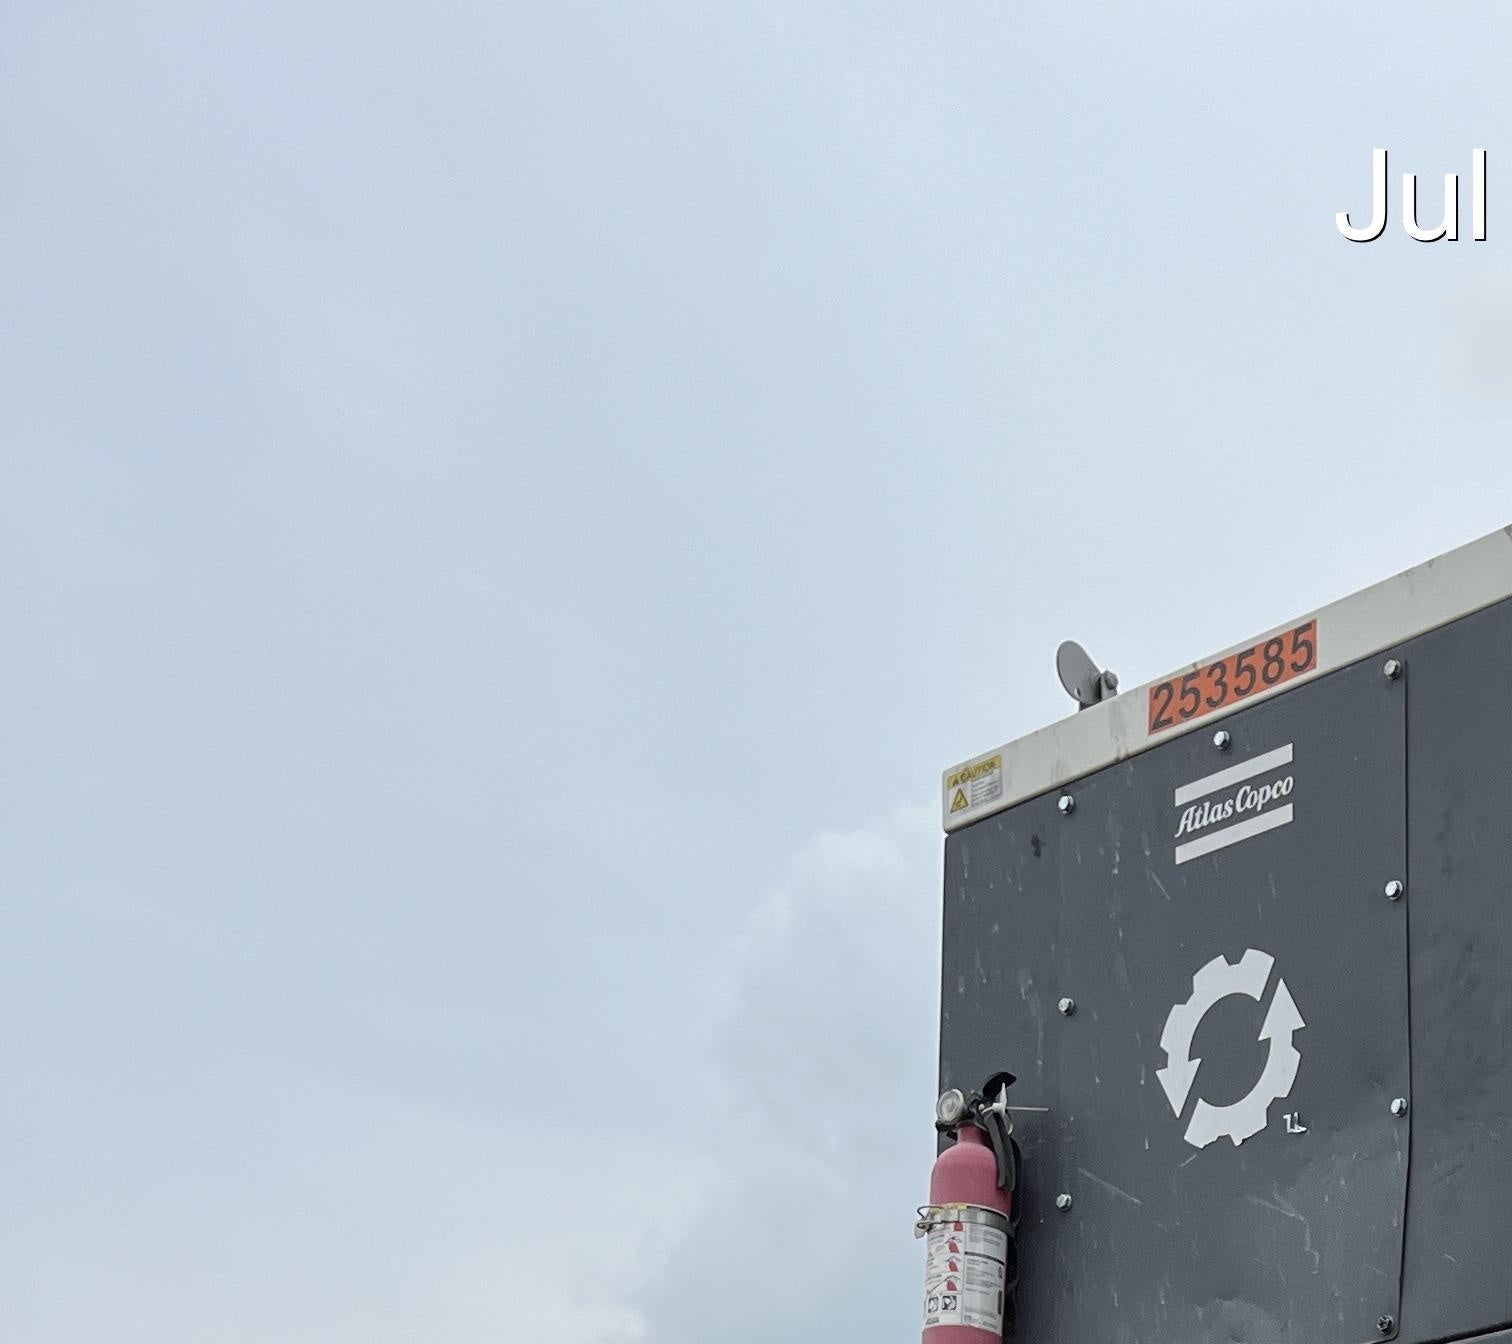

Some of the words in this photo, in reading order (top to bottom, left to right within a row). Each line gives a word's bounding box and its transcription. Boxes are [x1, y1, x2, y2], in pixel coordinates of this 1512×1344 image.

[1152, 622, 1313, 731] 253585
[1174, 797, 1234, 838] Atlas
[1235, 775, 1294, 813] Copco
